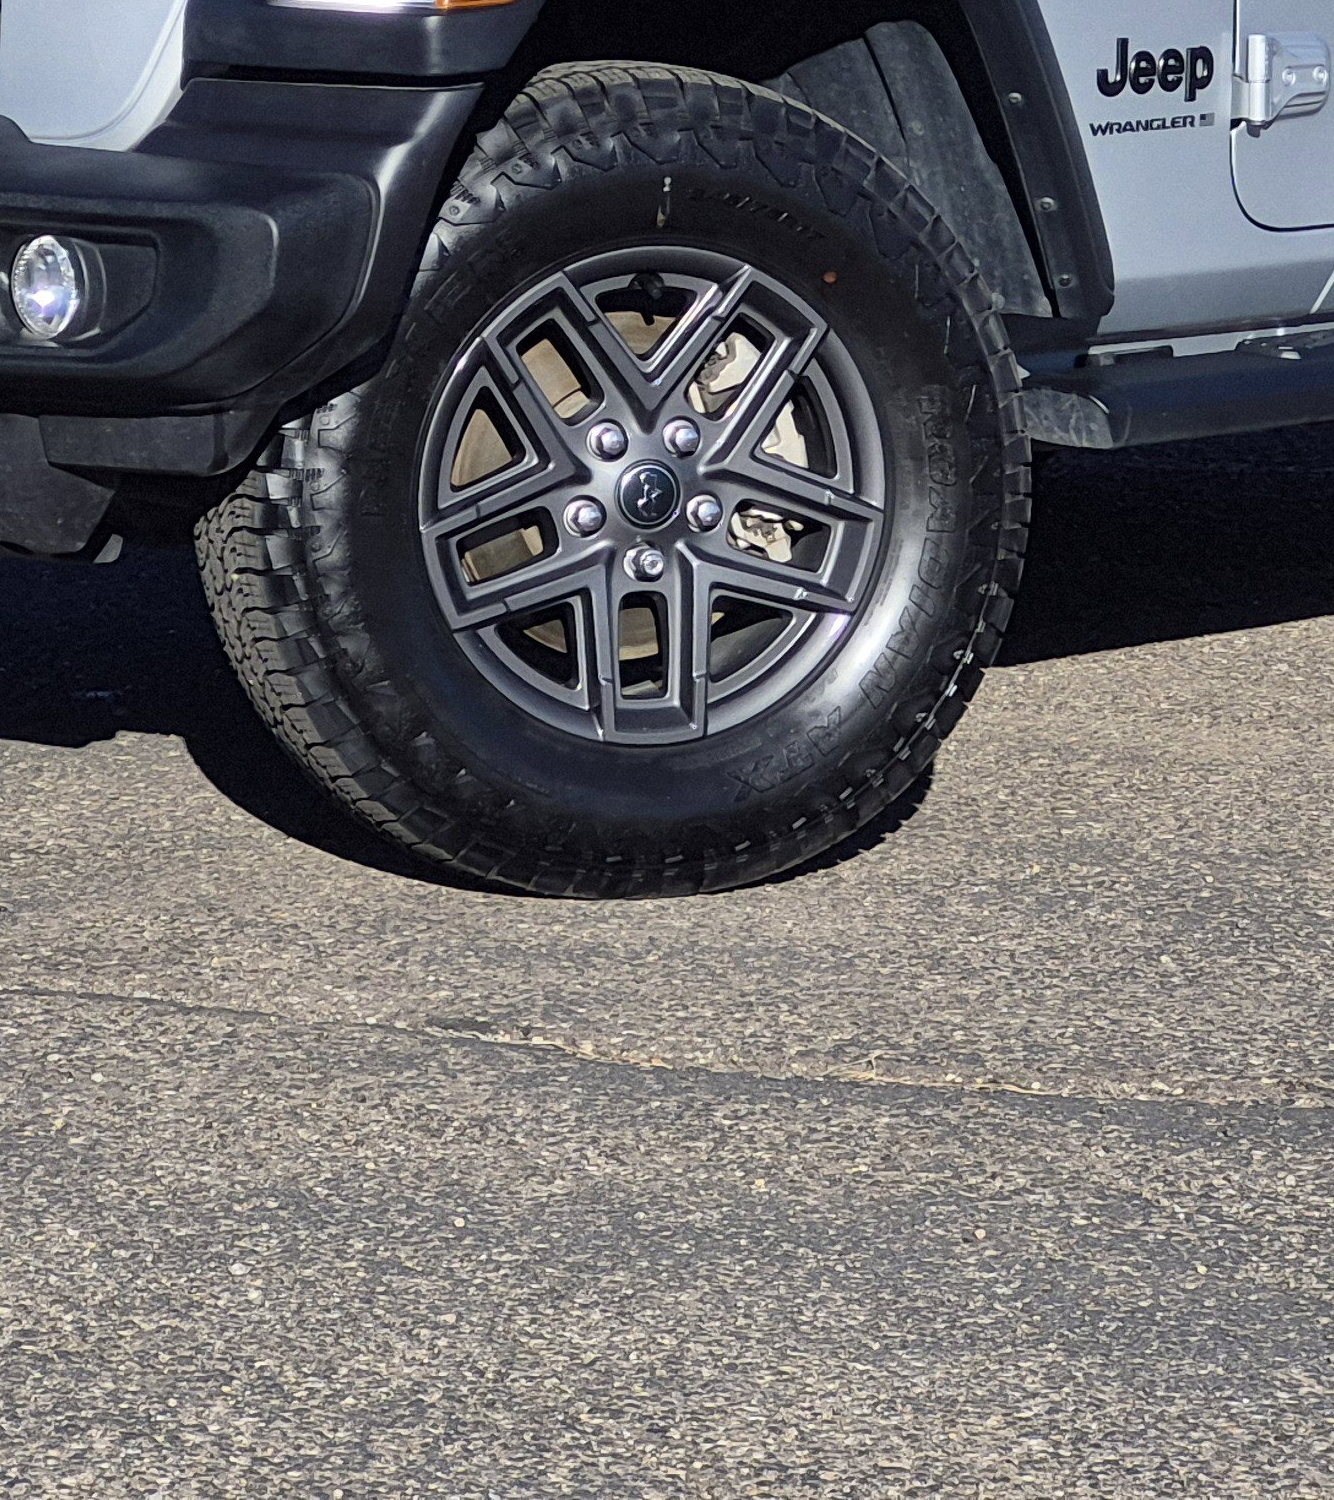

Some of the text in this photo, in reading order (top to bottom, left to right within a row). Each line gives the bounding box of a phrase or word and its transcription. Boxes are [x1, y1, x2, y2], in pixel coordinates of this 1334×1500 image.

[1096, 37, 1215, 103] Jeep
[1088, 113, 1196, 137] WRANGLER
[727, 392, 958, 800] ROADIAN ATX
